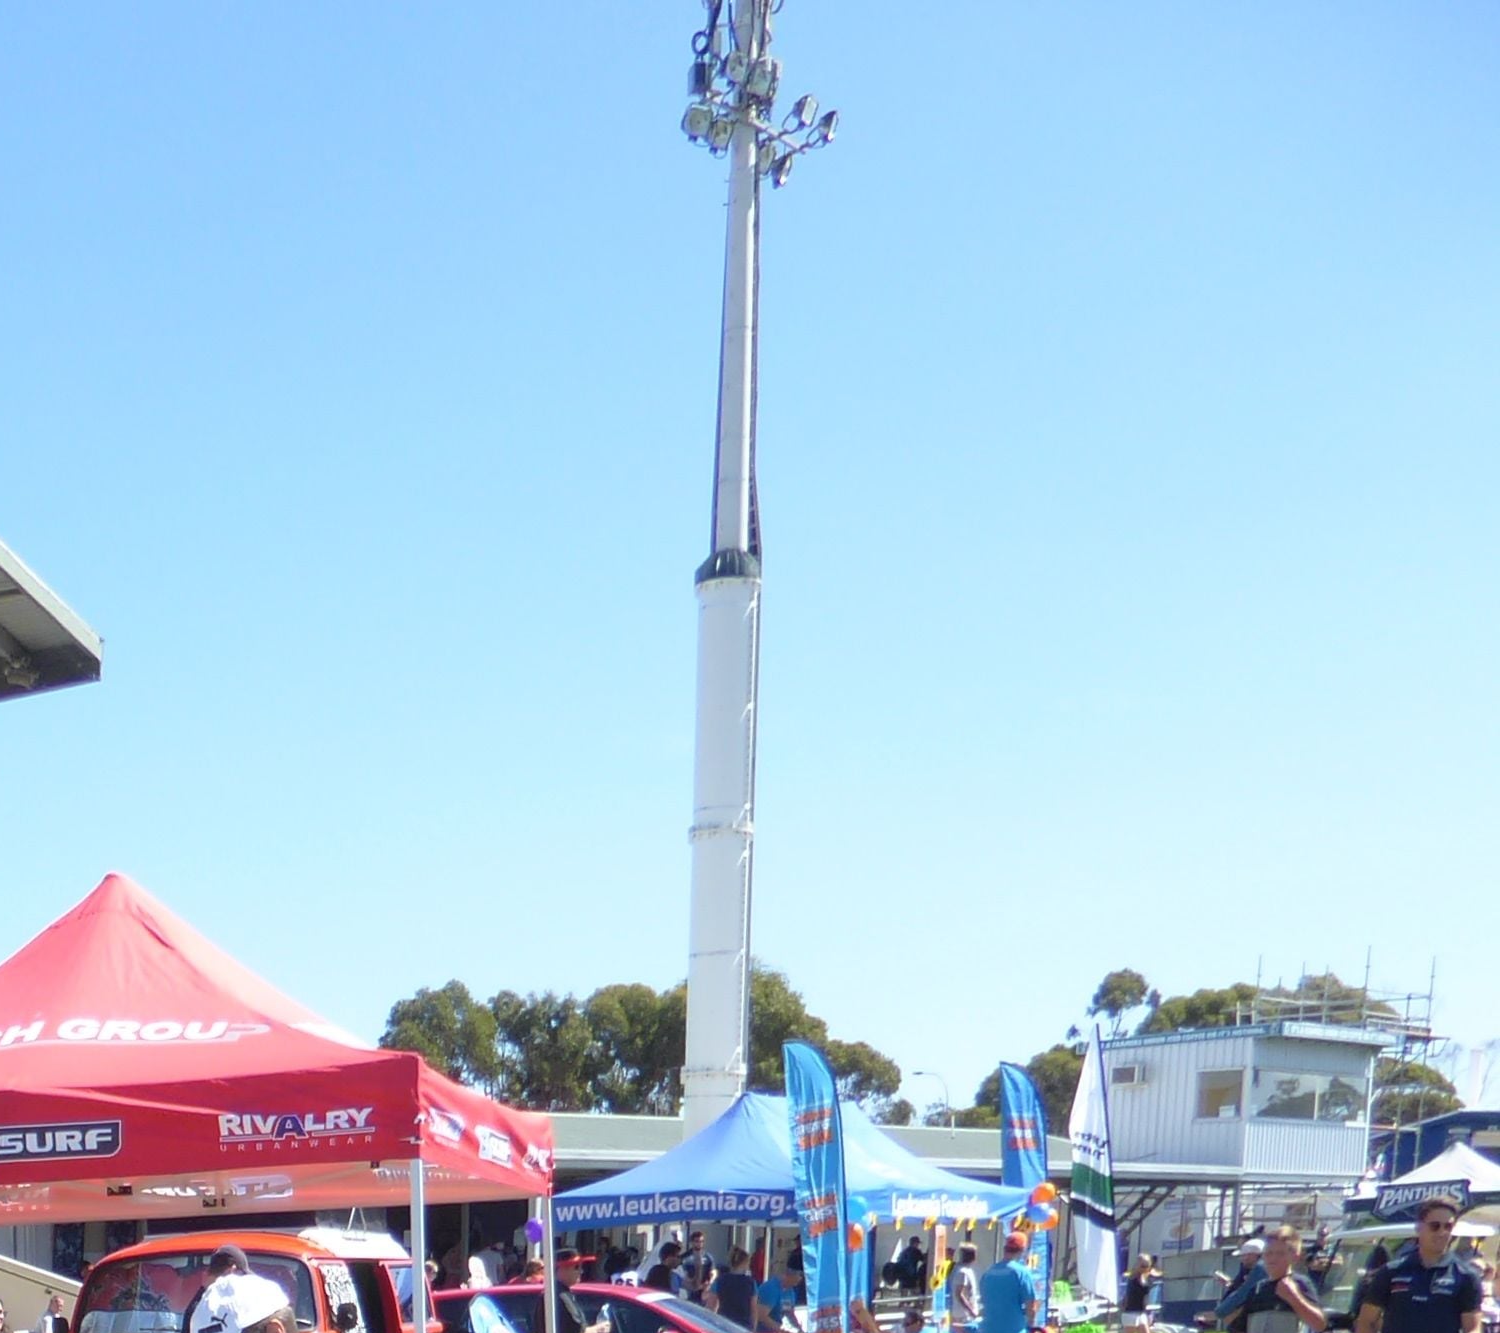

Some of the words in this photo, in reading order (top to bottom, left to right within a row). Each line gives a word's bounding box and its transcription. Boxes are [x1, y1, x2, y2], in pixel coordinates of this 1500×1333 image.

[57, 1018, 271, 1044] GROUP
[217, 1107, 373, 1140] RIVALRY
[1379, 1183, 1464, 1211] PANTHERS
